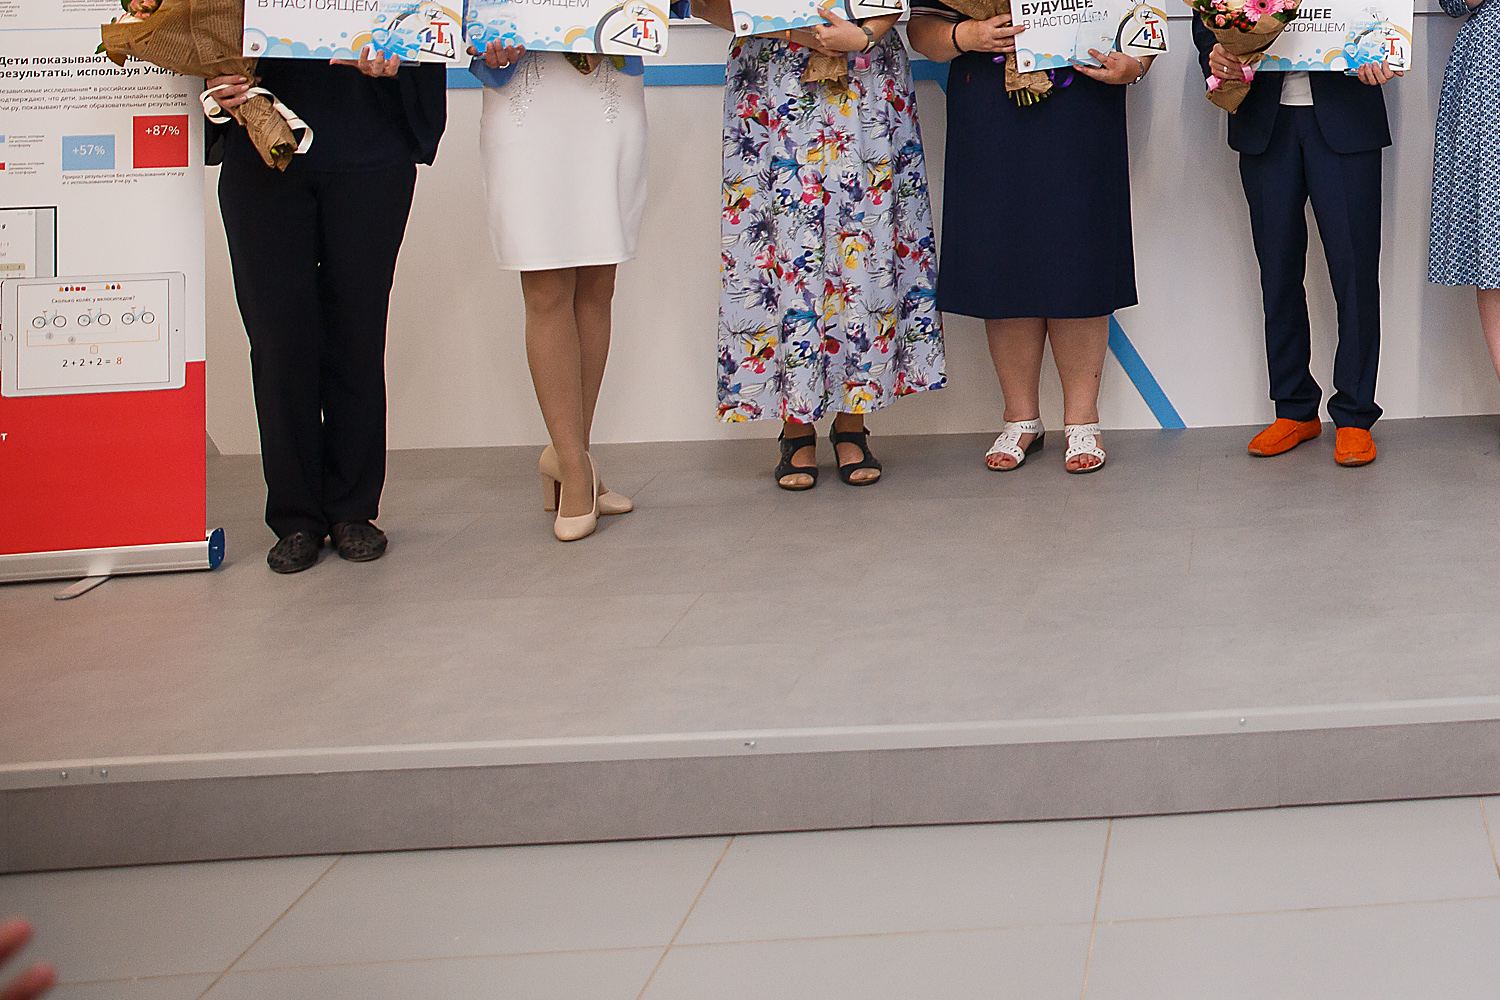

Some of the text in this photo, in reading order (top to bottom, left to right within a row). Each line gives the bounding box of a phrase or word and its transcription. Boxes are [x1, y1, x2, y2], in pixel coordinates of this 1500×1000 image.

[32, 55, 108, 65] показывают
[76, 66, 140, 78] используя
[145, 125, 180, 136] +87%
[72, 144, 106, 156] +57%
[62, 357, 122, 368] 2 2 2 8
